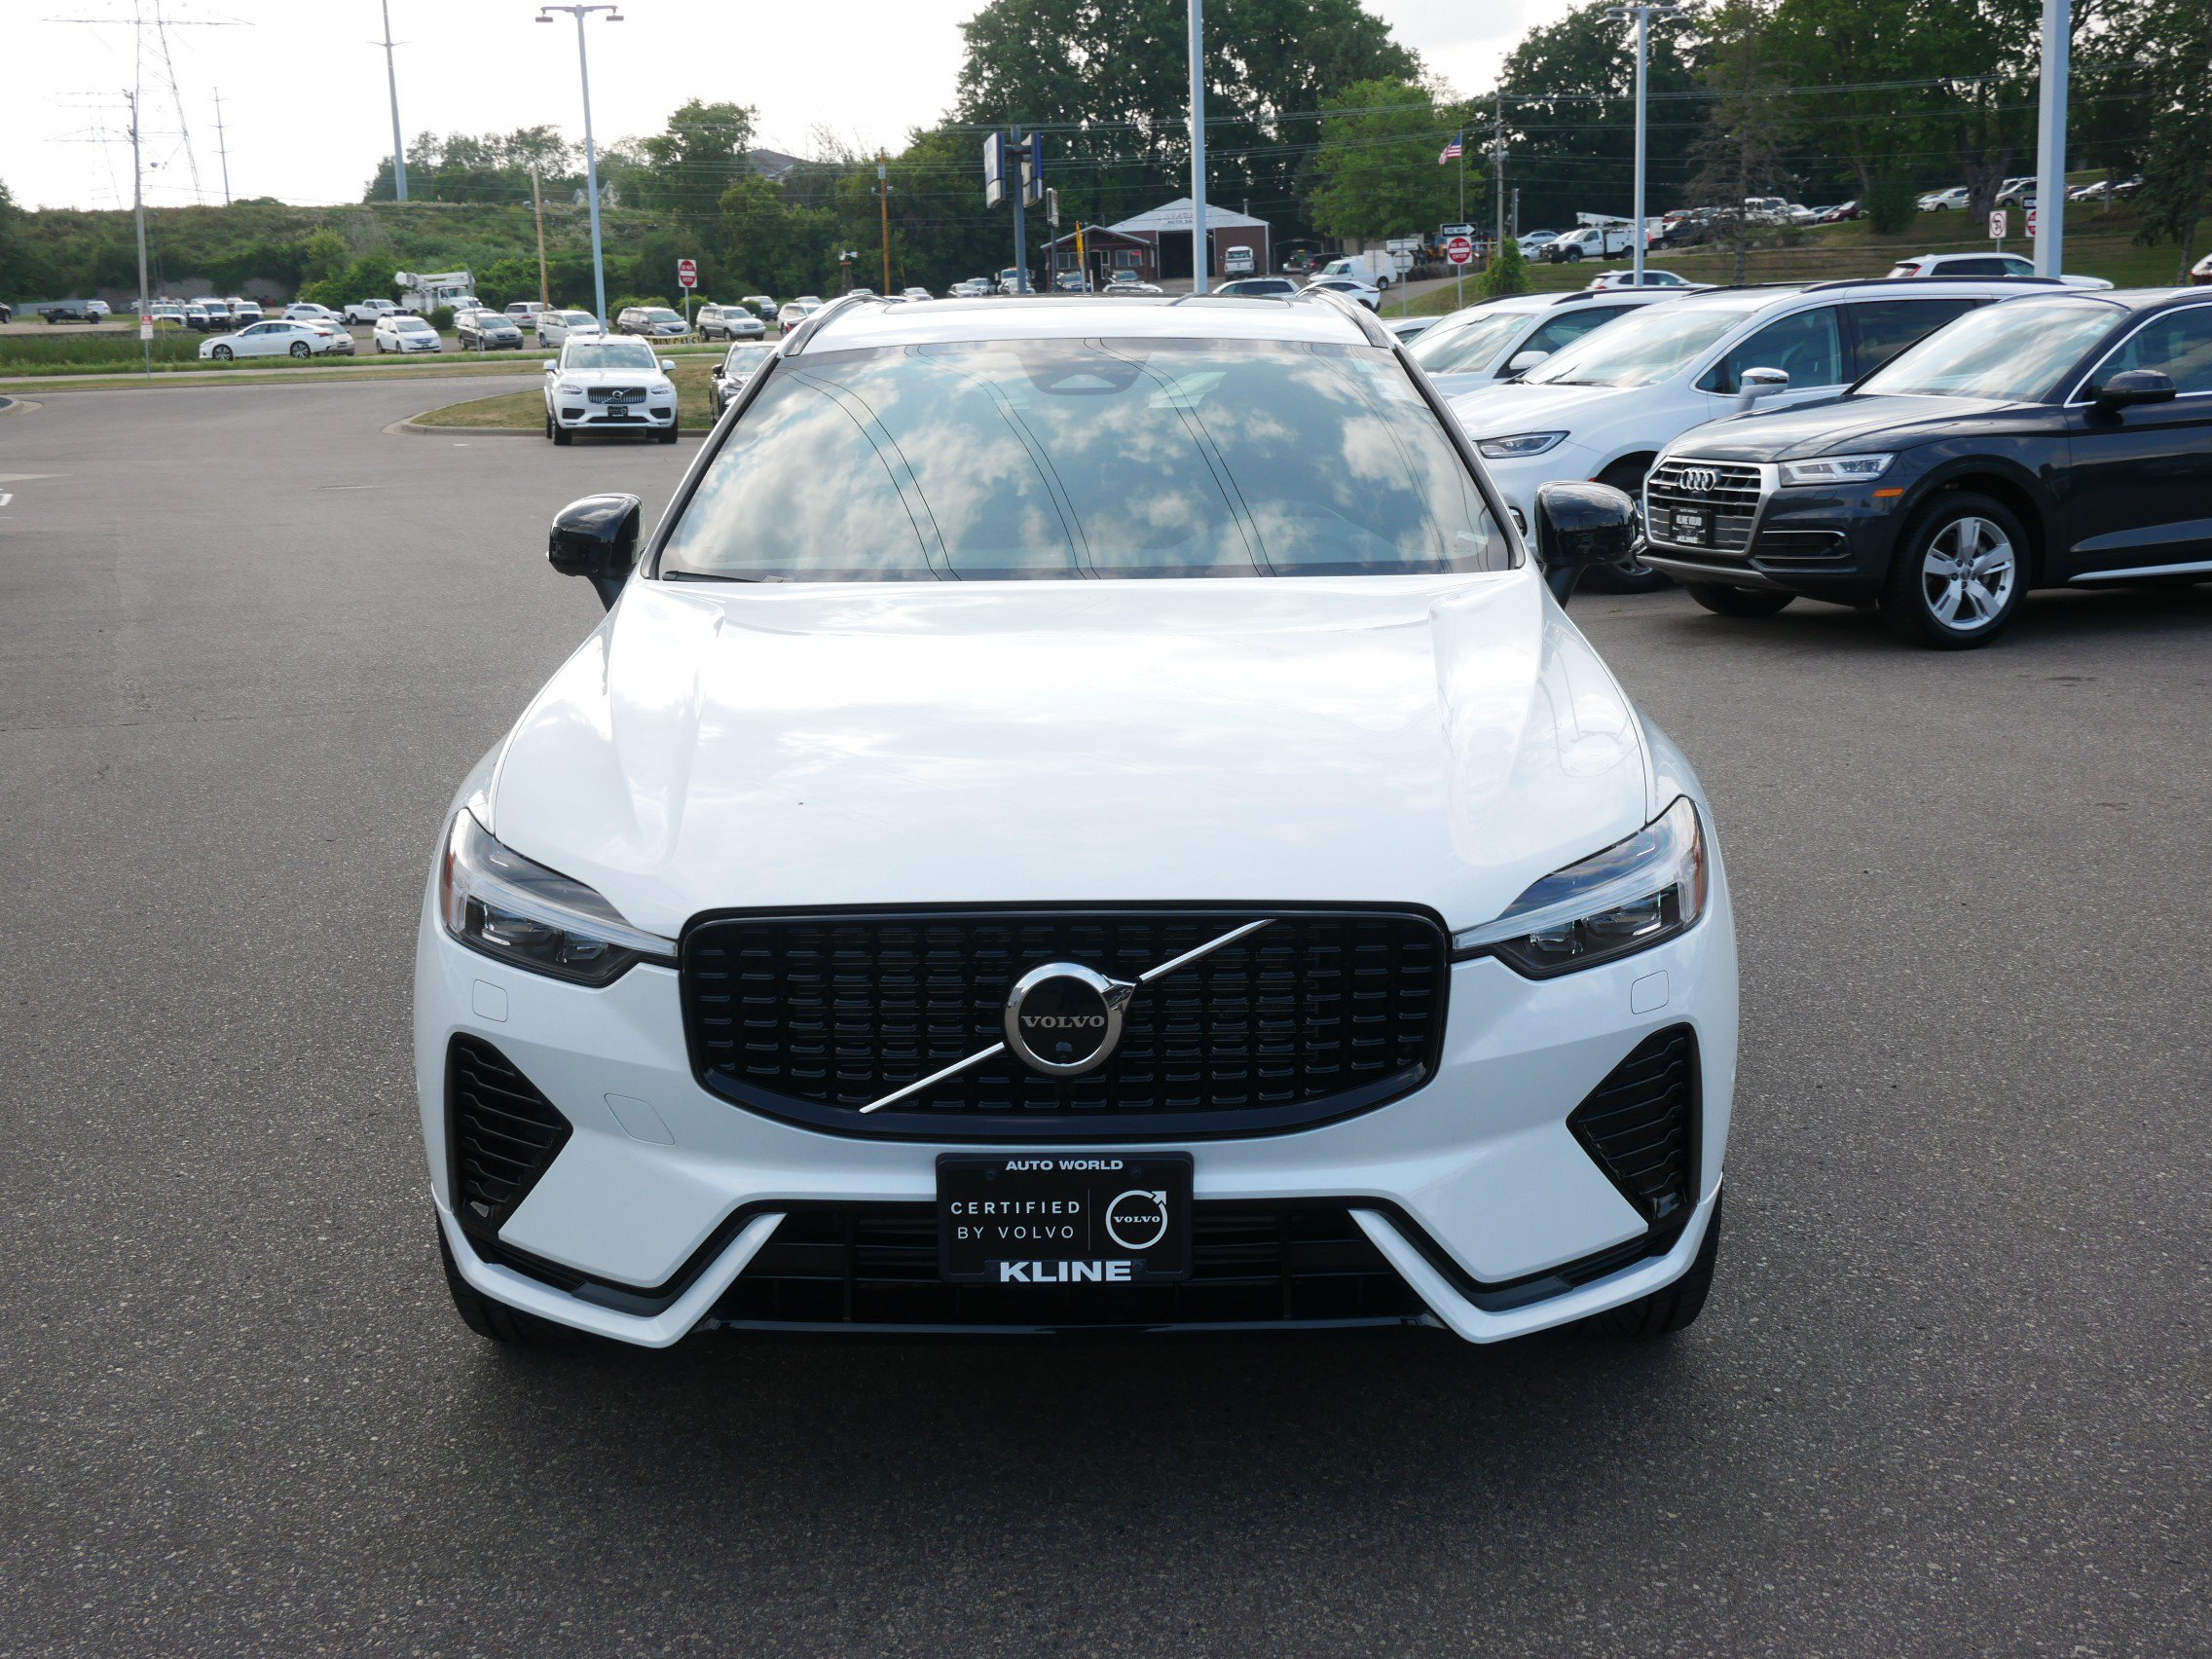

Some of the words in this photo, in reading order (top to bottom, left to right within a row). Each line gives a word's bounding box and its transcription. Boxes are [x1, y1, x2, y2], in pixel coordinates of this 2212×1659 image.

[1020, 1015, 1105, 1028] VOLVO
[1005, 1160, 1053, 1170] AUTO
[1059, 1160, 1124, 1170] WORLD
[950, 1200, 1081, 1215] CERTIFIED
[1113, 1215, 1161, 1224] VOLVO
[957, 1226, 984, 1239] BY
[999, 1225, 1075, 1239] VOLVO
[1000, 1261, 1131, 1282] KLINE
